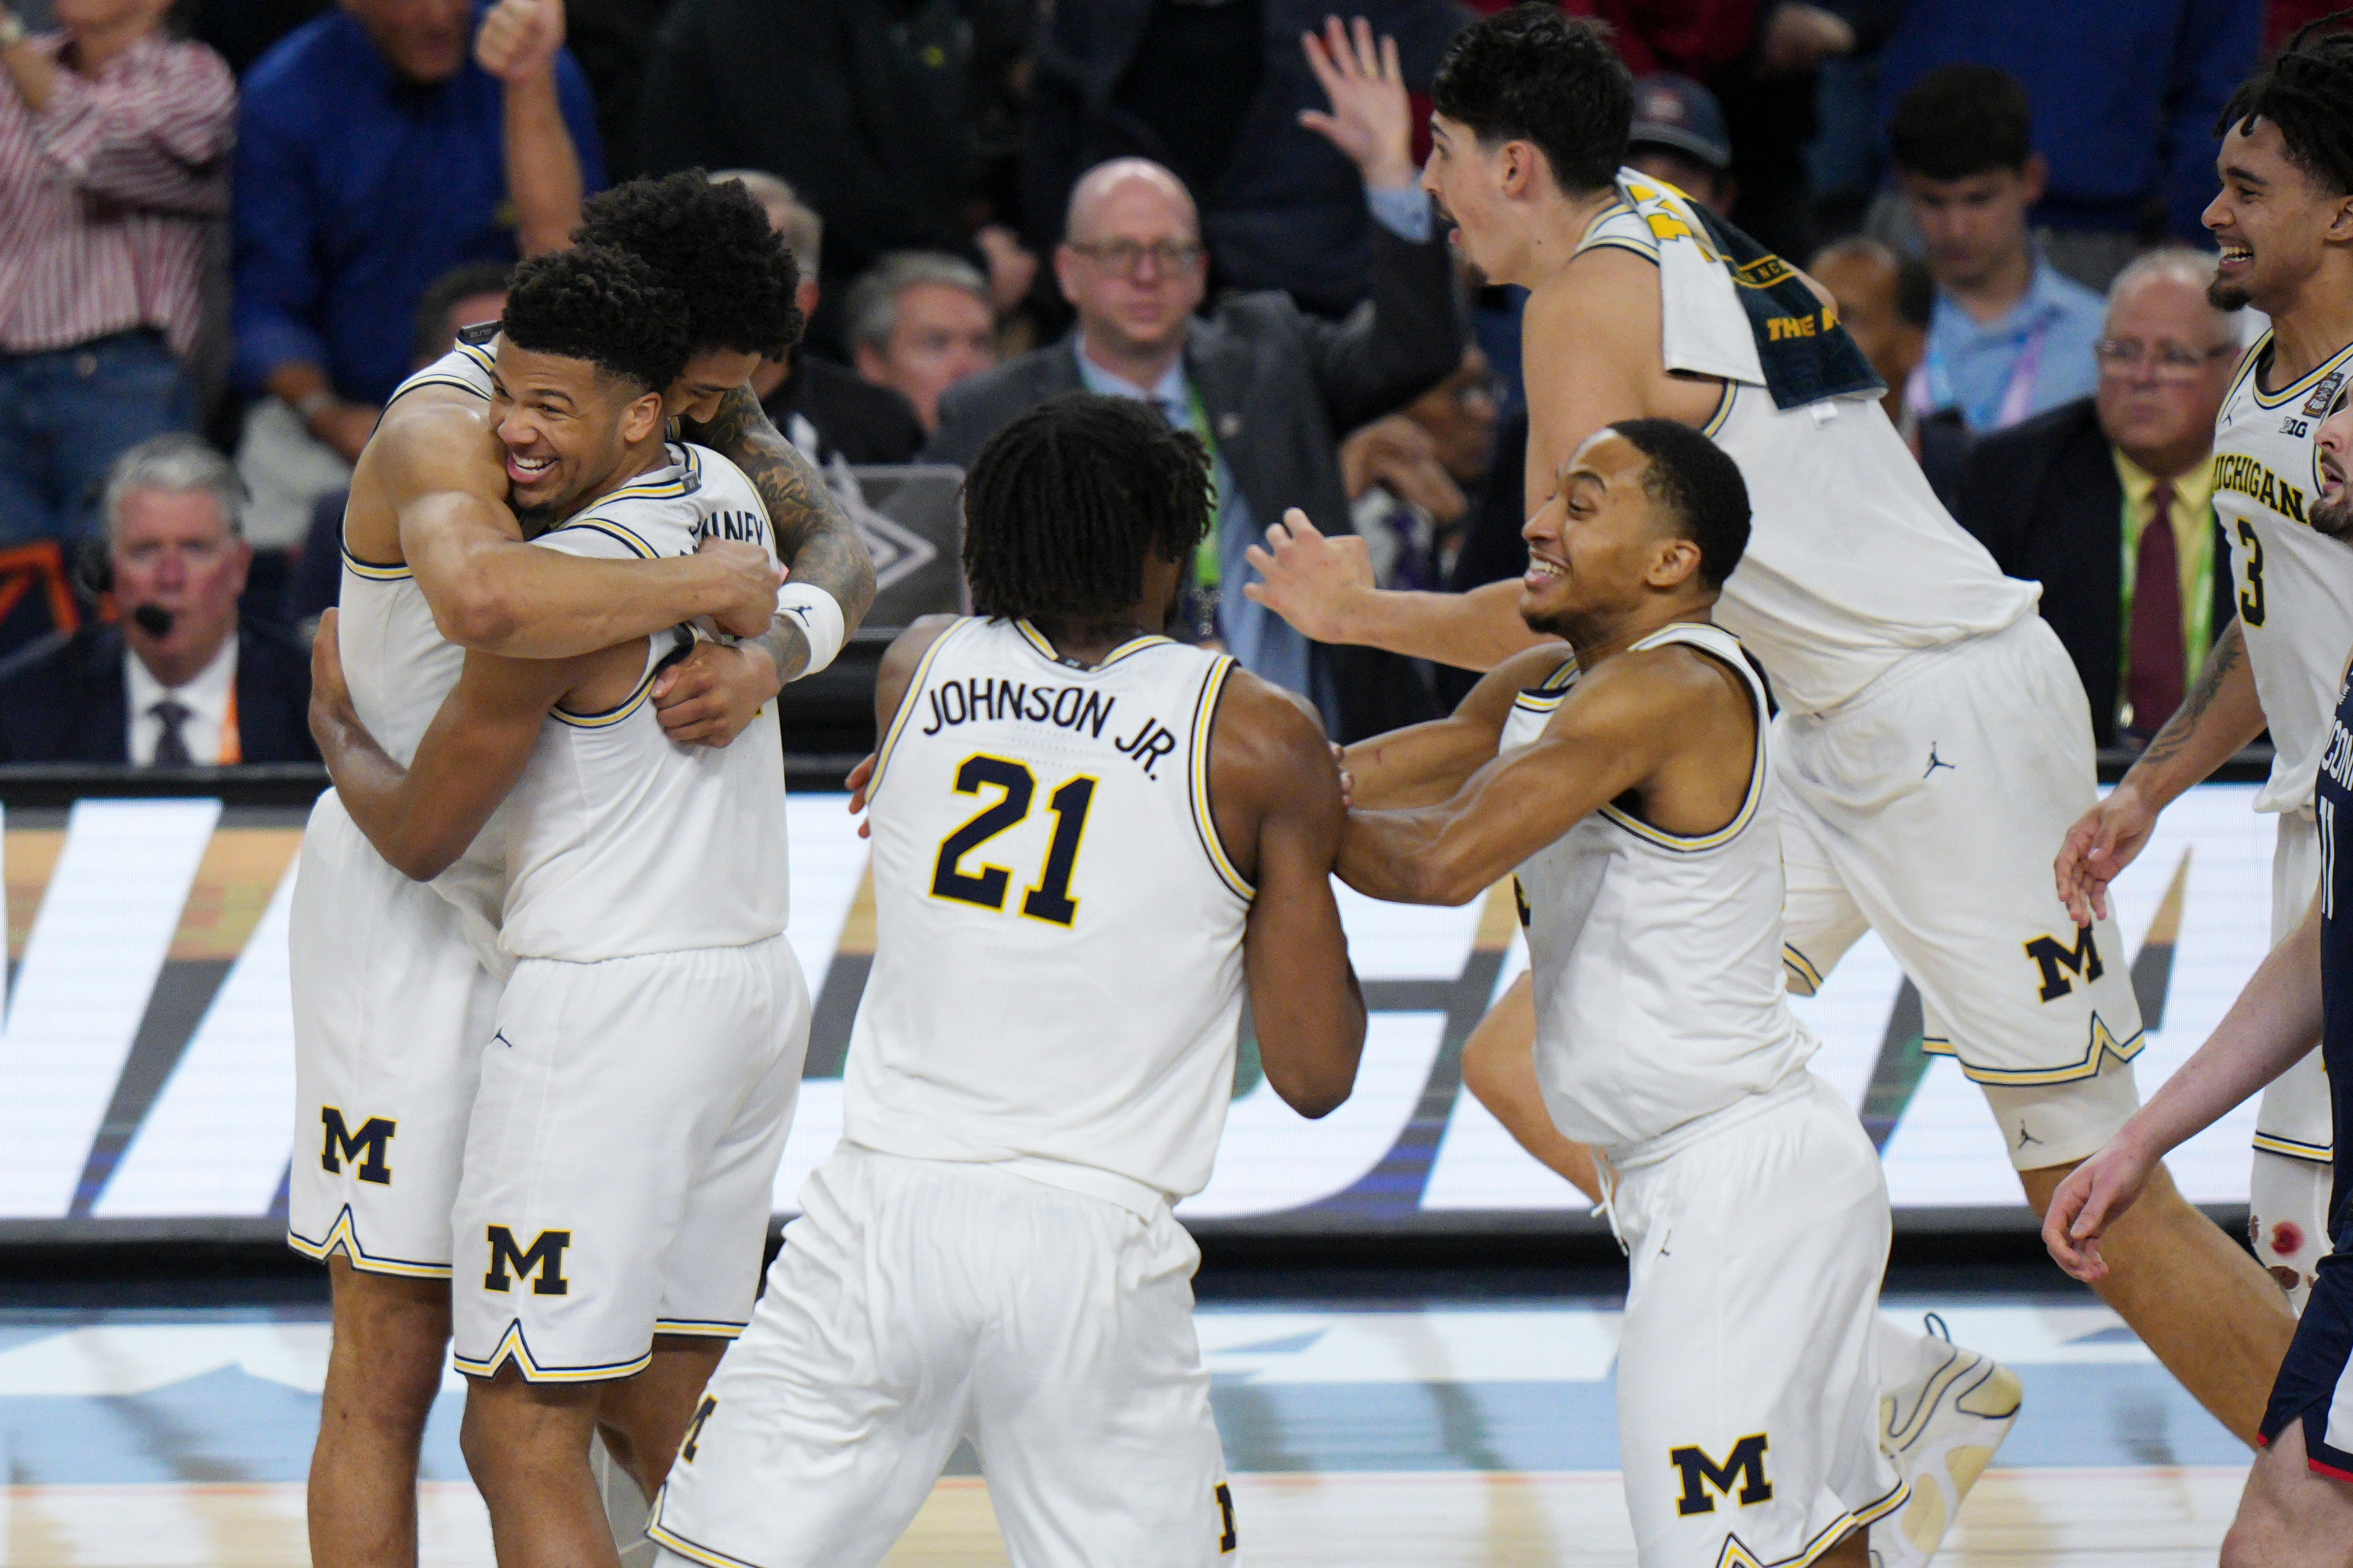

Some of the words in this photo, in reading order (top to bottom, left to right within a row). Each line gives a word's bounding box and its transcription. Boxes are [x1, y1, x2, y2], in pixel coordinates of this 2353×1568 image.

[1766, 315, 1816, 341] THE
[2237, 516, 2266, 628] 3
[923, 678, 1115, 739] JOHNSON
[1115, 717, 1176, 781] JR.
[928, 750, 1100, 930] 21
[2319, 795, 2334, 921] 11
[2022, 919, 2104, 1004] M
[322, 1104, 398, 1186] M
[484, 1223, 572, 1296] M
[1669, 1431, 1772, 1517] M
